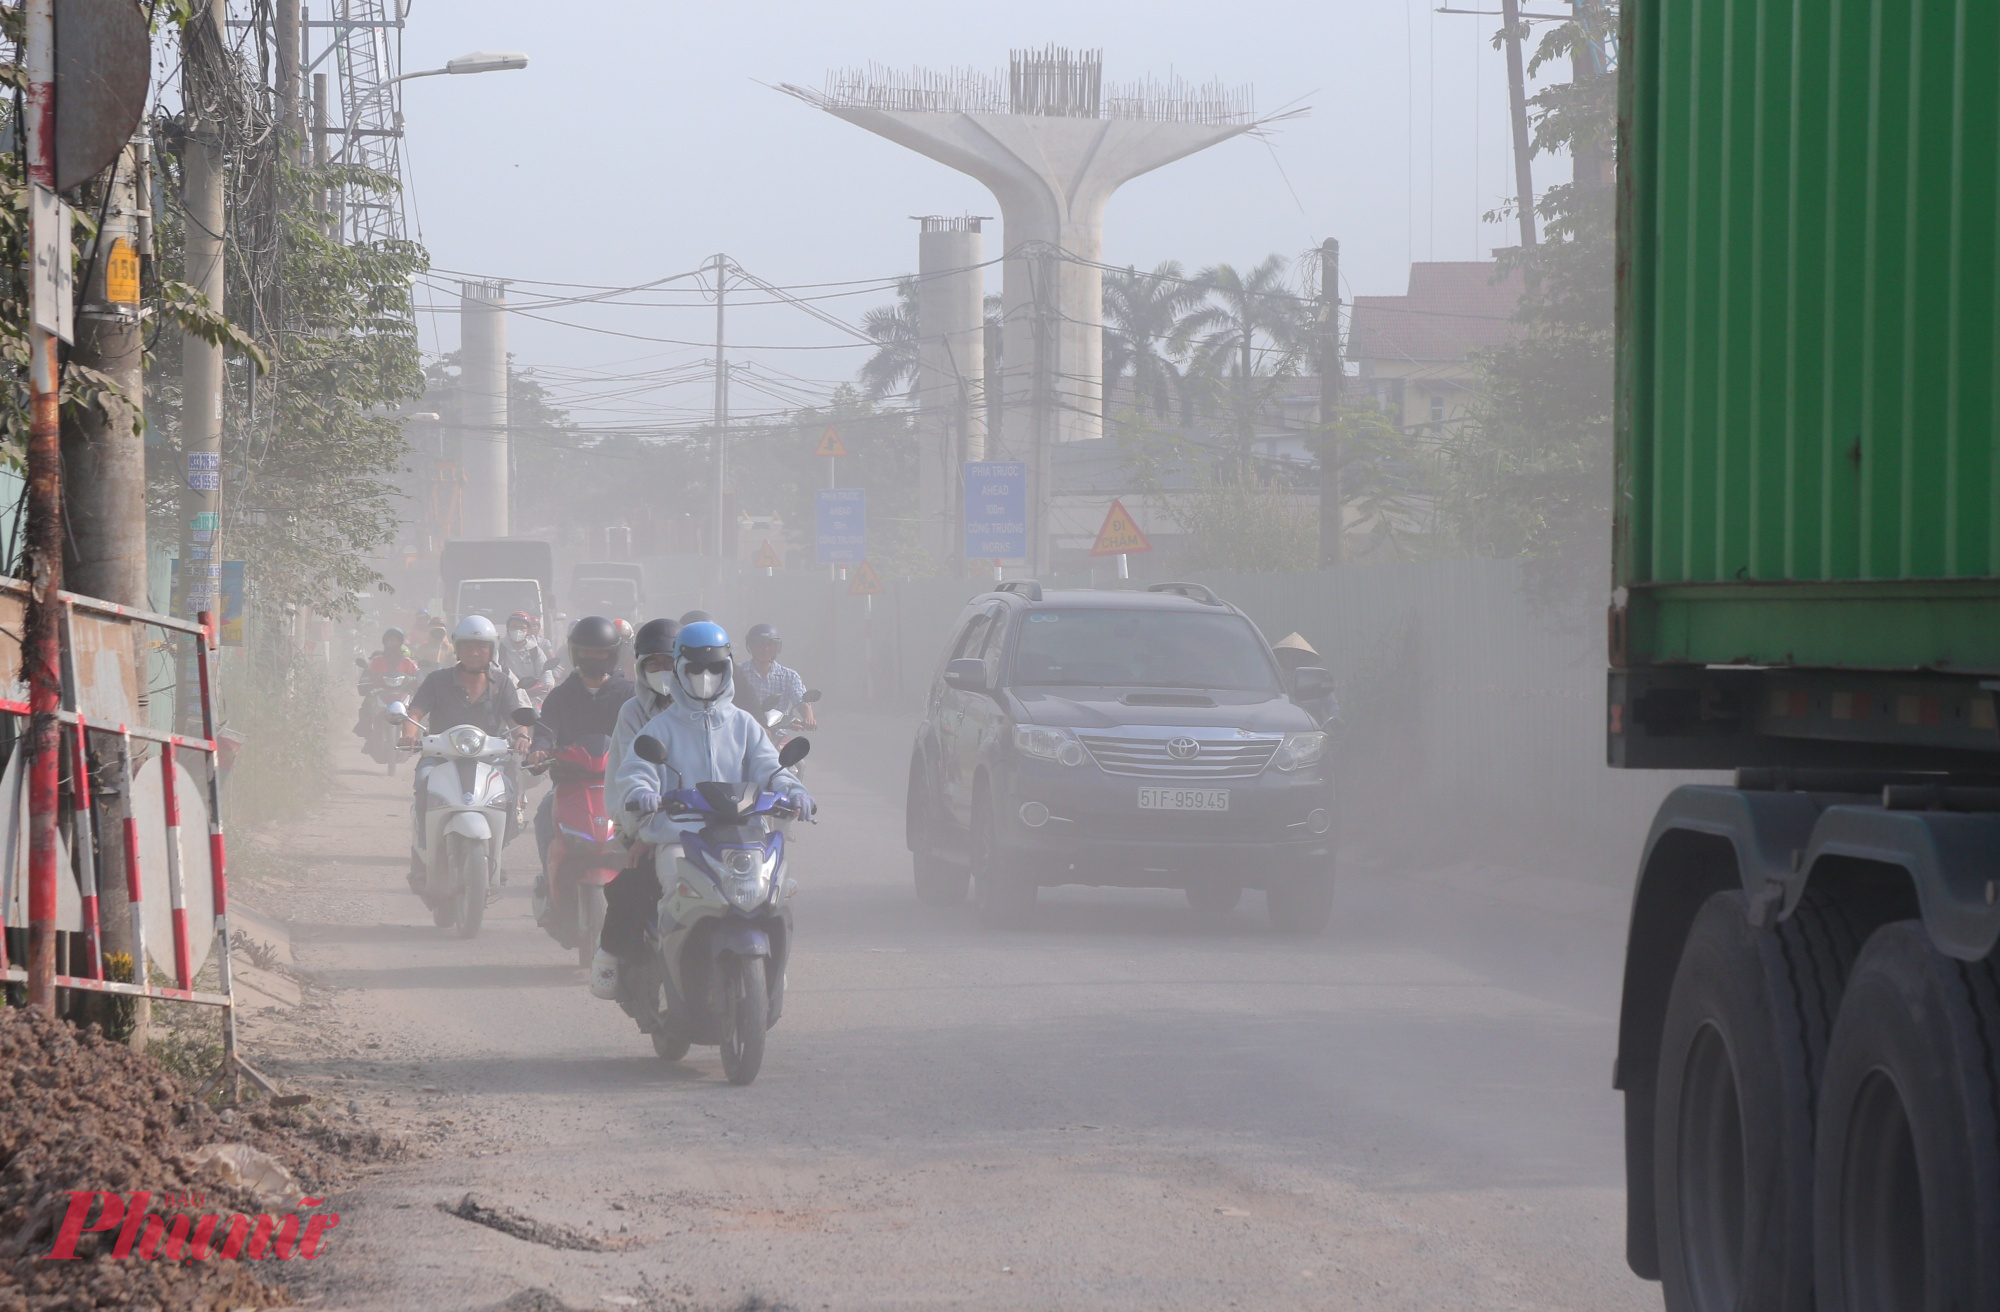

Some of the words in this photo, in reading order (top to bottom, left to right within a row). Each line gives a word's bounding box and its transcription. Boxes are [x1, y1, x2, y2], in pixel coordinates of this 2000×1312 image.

[982, 485, 1009, 496] AHEAD
[830, 507, 852, 515] AHEAD
[986, 504, 1005, 515] 100m
[968, 521, 990, 534] CÔNG
[1113, 520, 1125, 531] ĐI
[981, 542, 1011, 553] WORKS
[1140, 790, 1226, 809] 51F-959.45
